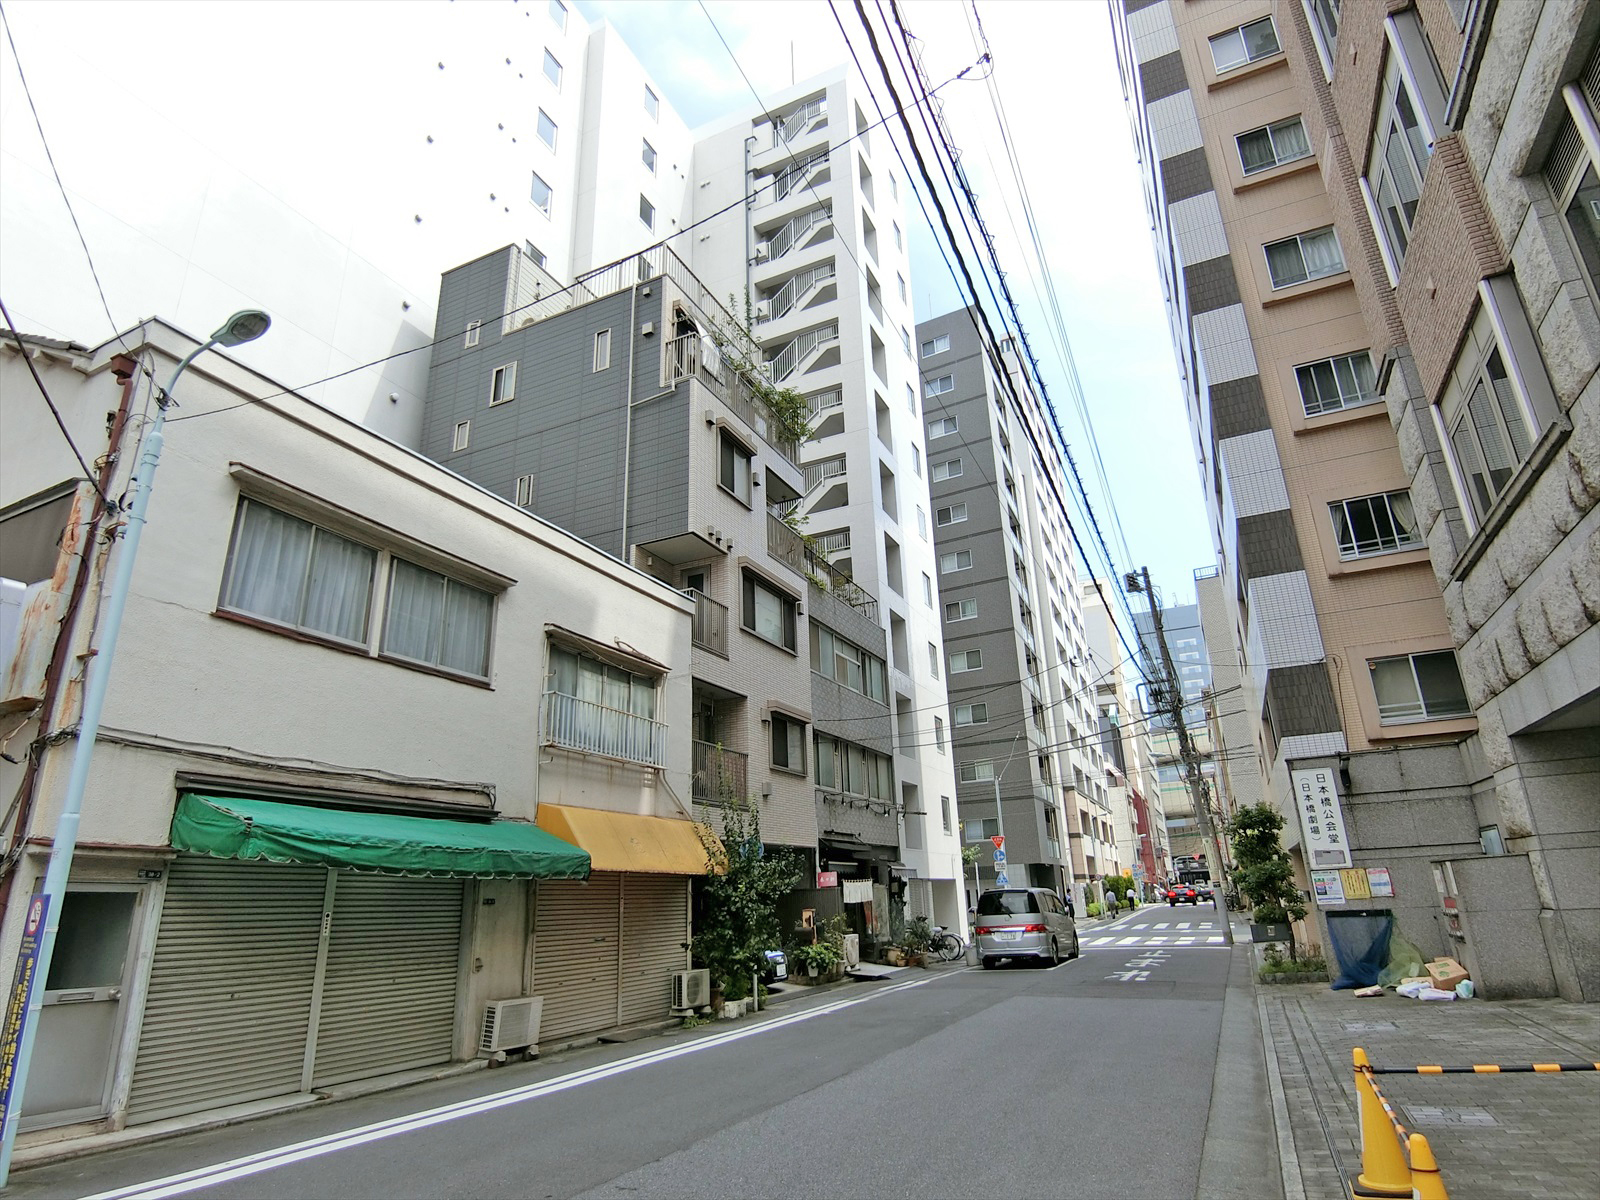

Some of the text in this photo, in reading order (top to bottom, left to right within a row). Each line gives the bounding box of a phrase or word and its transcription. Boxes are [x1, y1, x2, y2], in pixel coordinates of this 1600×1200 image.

[1315, 773, 1340, 844] 日本橋公会堂
[1104, 950, 1172, 982] 止まれ
